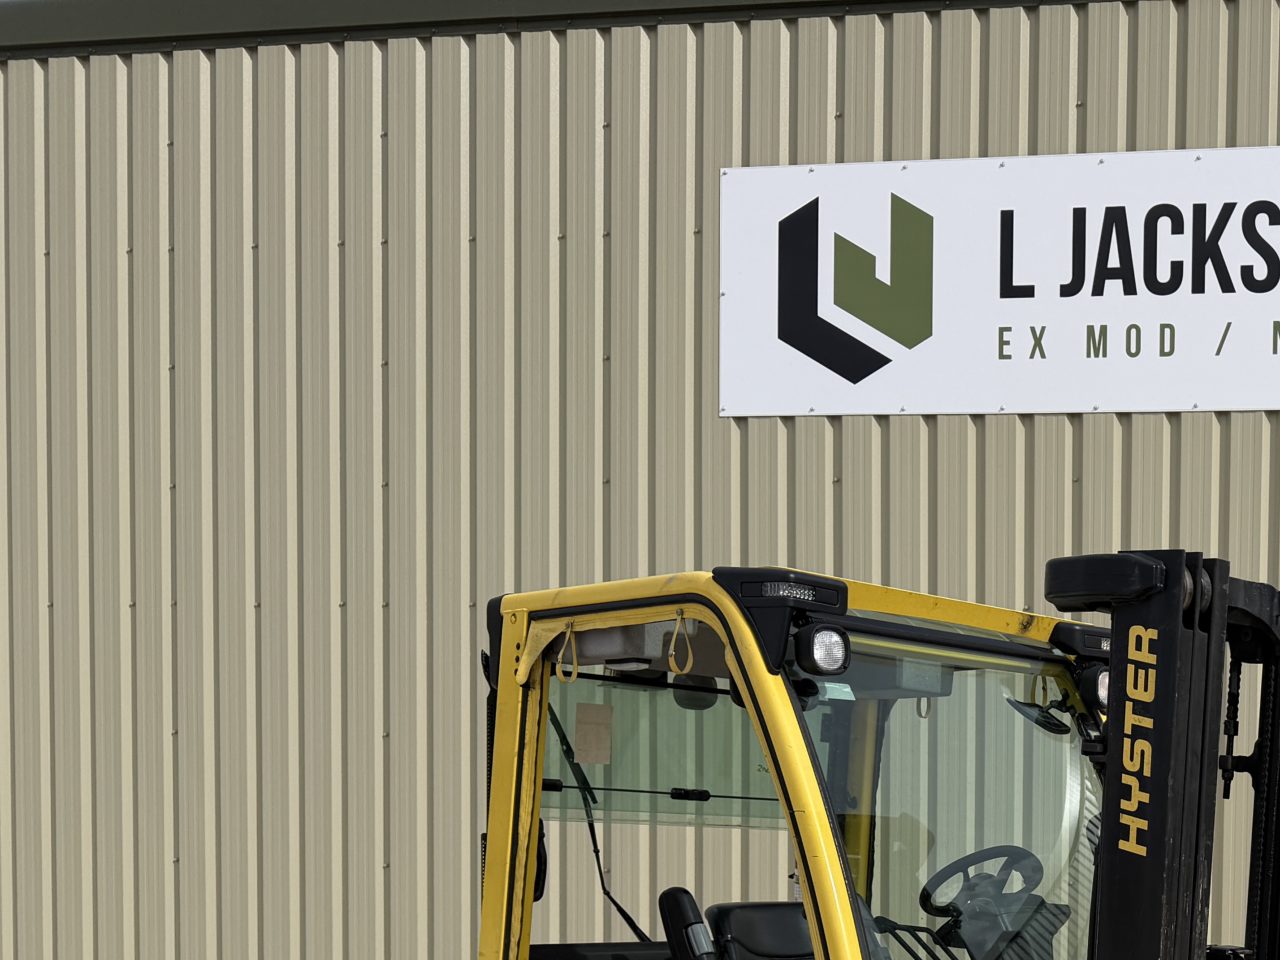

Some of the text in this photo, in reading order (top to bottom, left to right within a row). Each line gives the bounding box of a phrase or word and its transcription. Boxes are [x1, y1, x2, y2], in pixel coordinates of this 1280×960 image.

[999, 209, 1036, 299] L
[998, 325, 1047, 360] EX
[1086, 323, 1176, 359] MOD
[1118, 624, 1159, 857] HYSTER
